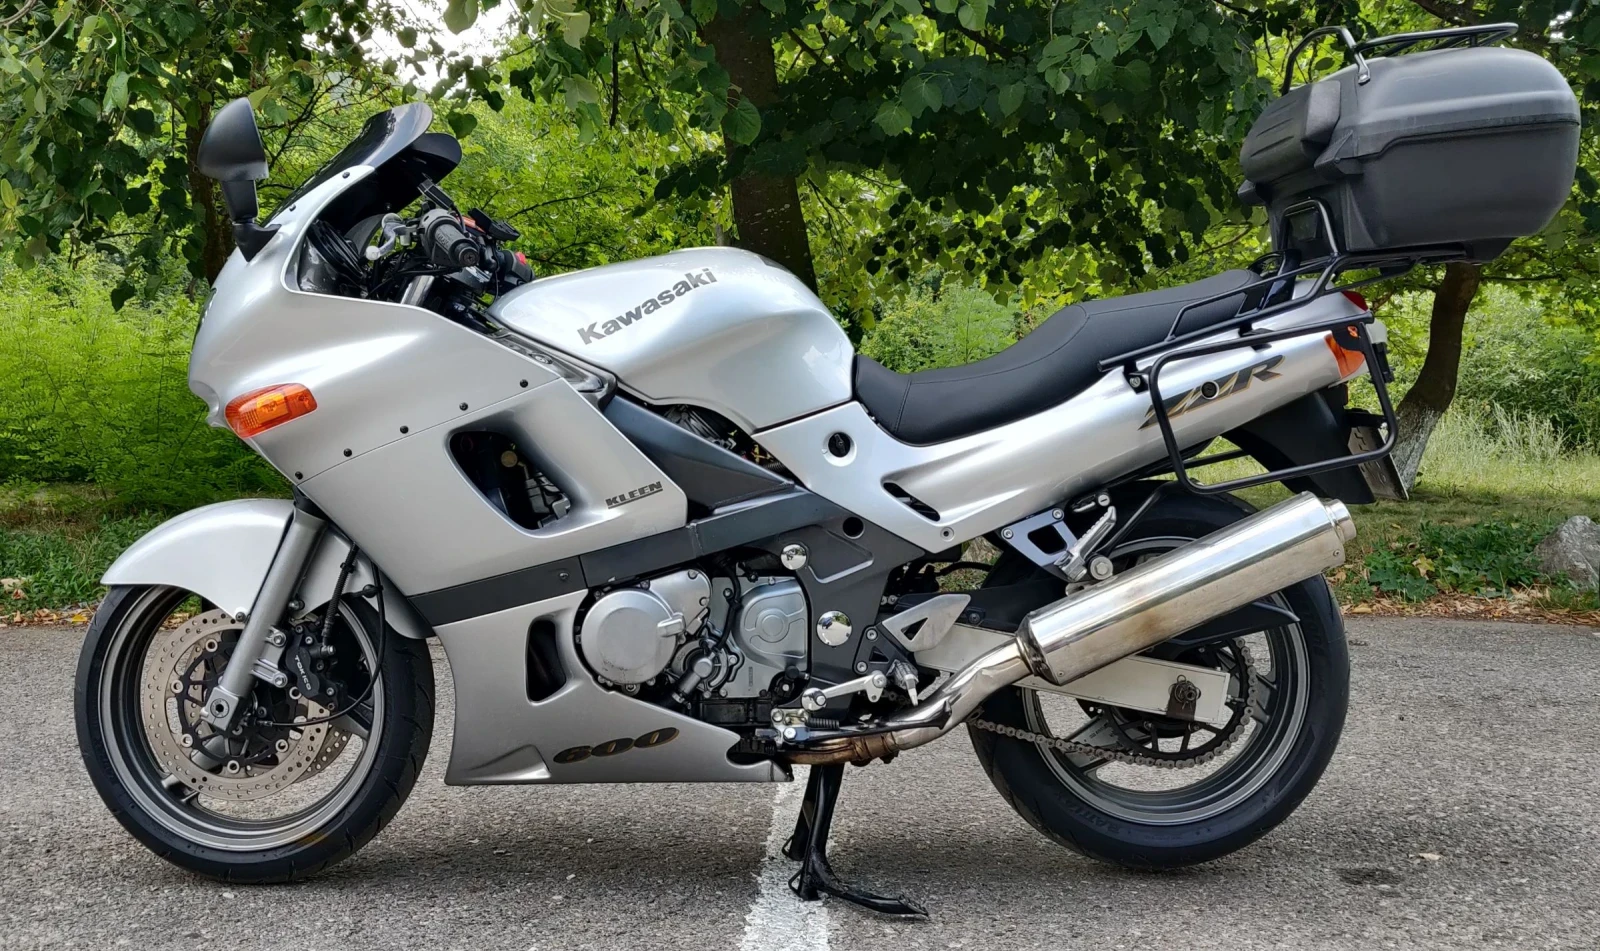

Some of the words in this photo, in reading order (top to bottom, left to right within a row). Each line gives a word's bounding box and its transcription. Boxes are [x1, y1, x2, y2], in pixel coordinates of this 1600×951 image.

[577, 268, 717, 345] Kawasaki
[605, 481, 662, 507] KLEEN
[294, 654, 312, 691] TOKICO
[552, 727, 680, 764] 600
